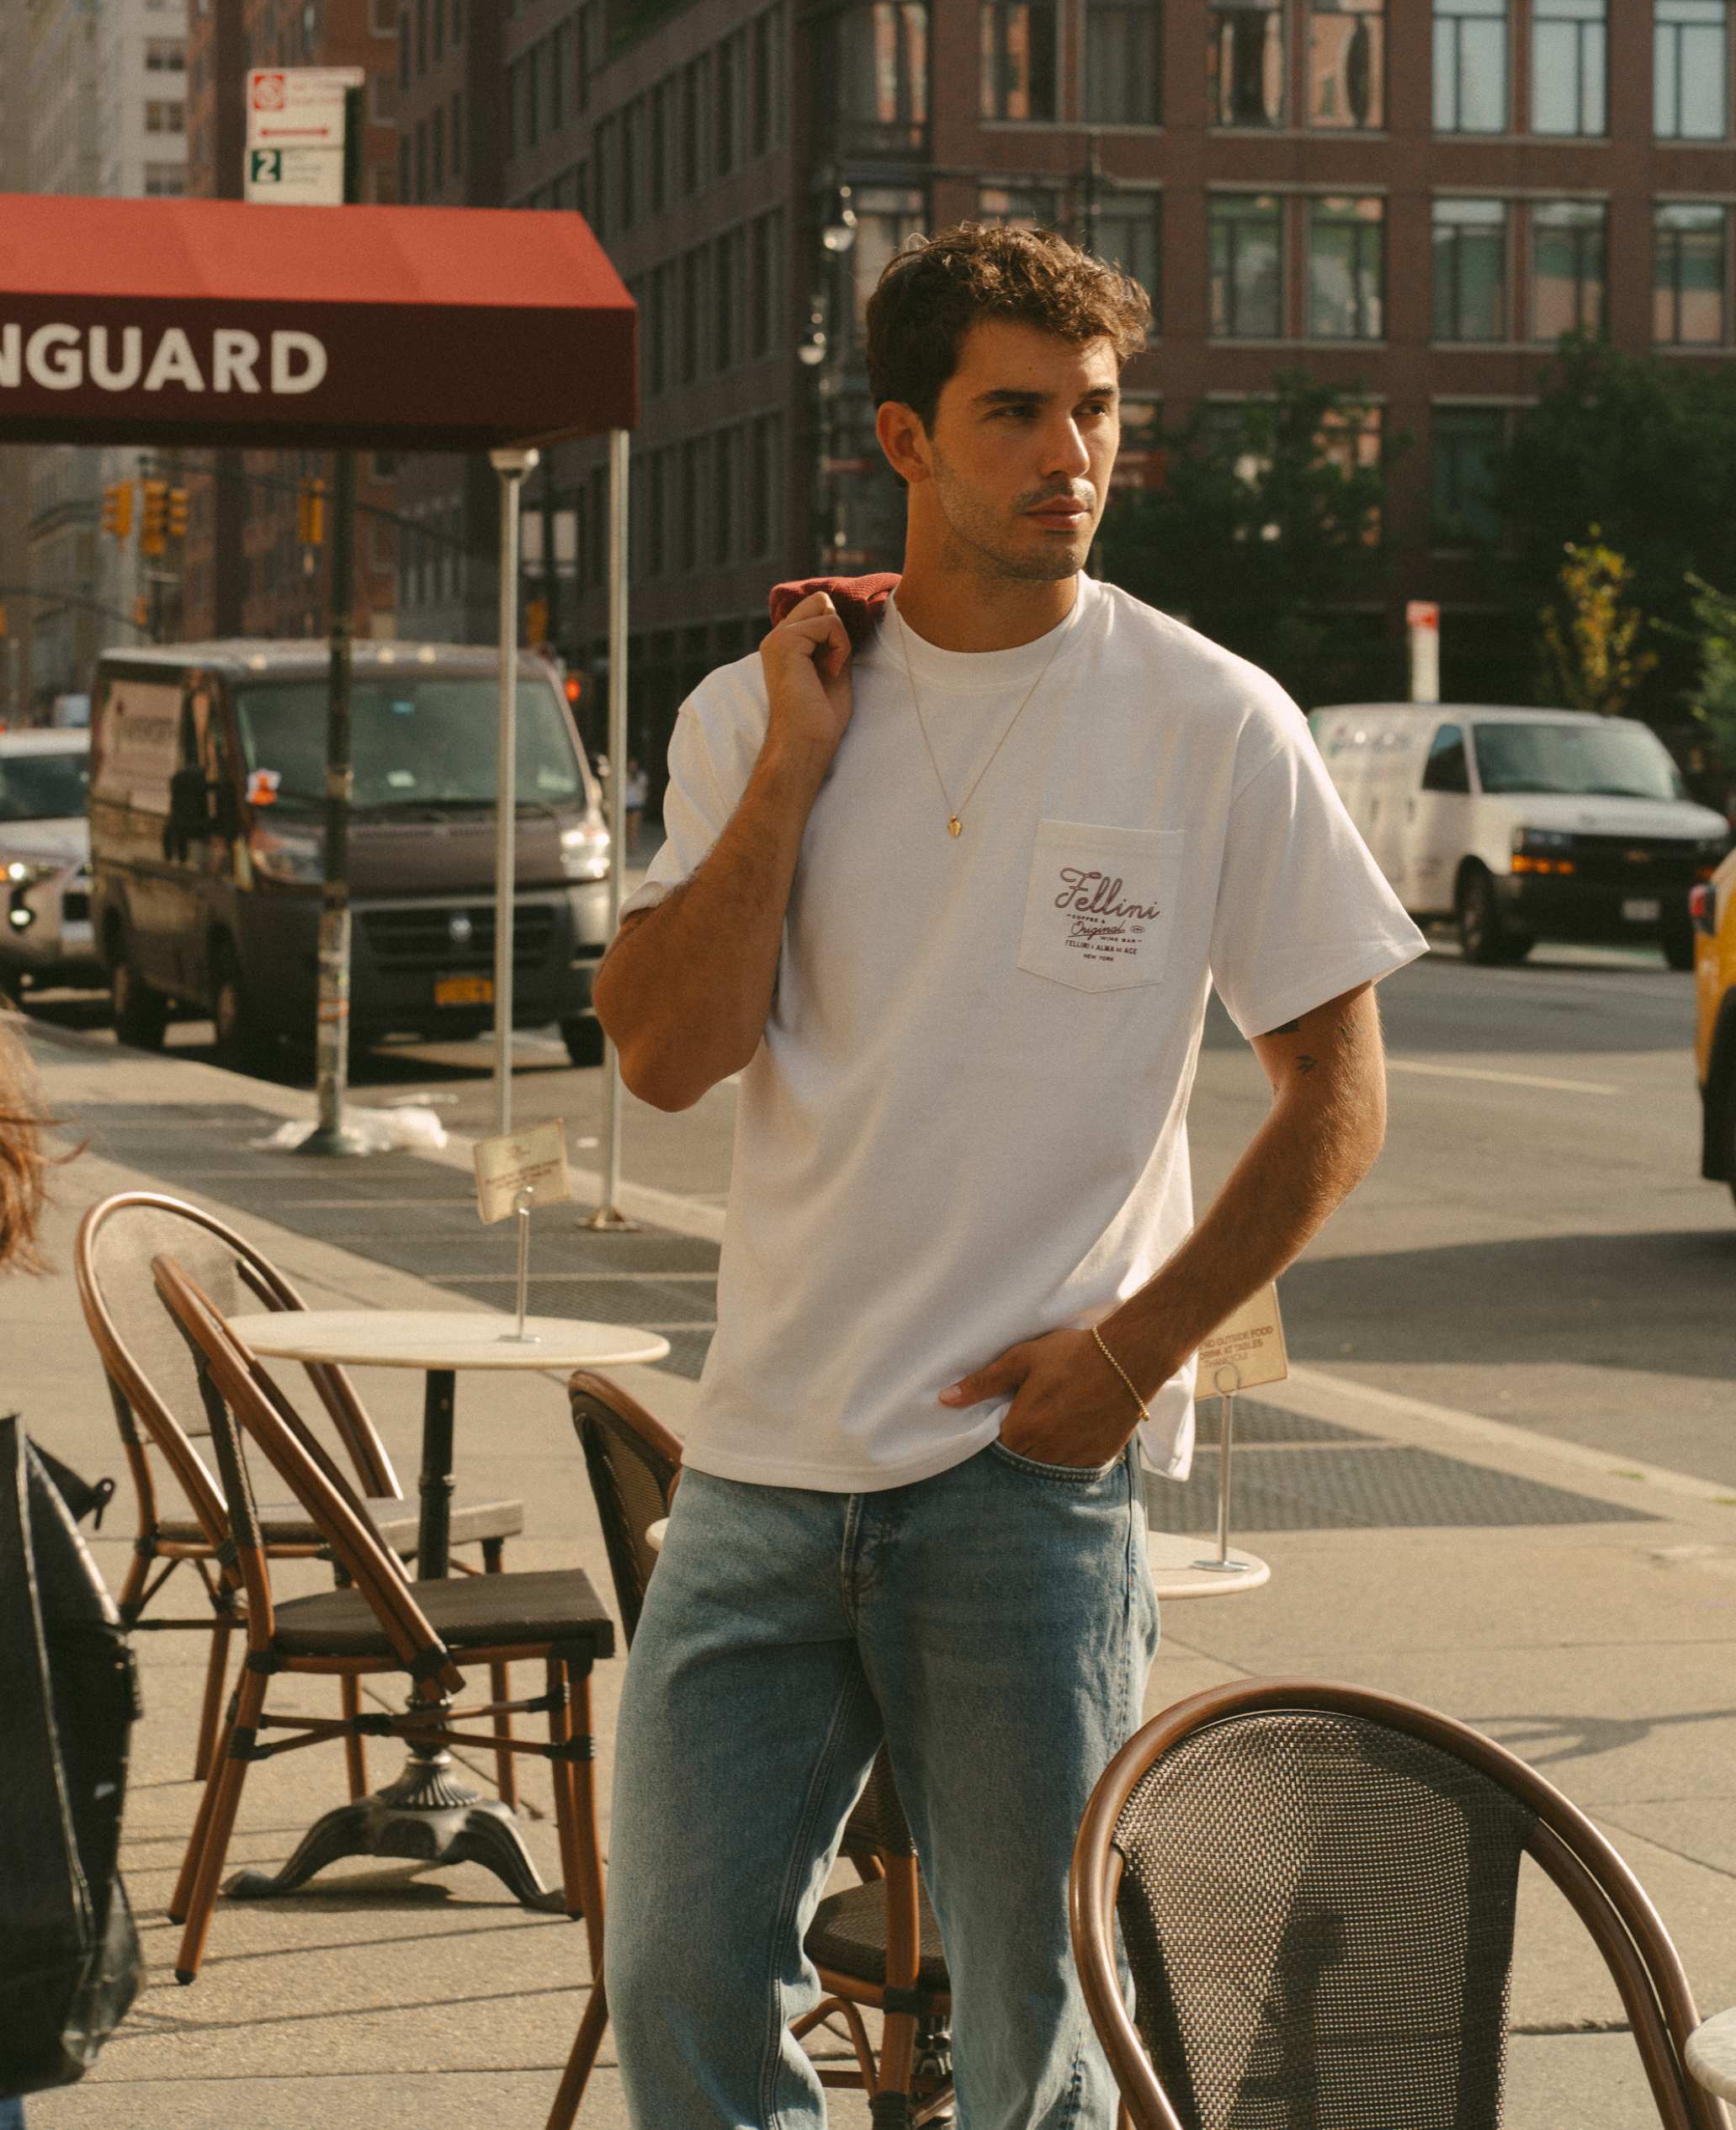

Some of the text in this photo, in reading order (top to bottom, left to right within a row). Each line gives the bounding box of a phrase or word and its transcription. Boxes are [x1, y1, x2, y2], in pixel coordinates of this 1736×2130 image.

[1054, 867, 1160, 920] Fellini
[1072, 915, 1098, 923] COFFEE
[1070, 920, 1126, 940] Original
[1064, 940, 1090, 948] FELLINI
[1205, 1338, 1216, 1348] NO
[1217, 1331, 1250, 1346] OUTSIDE
[1250, 1326, 1273, 1338] FOOD
[1199, 1339, 1263, 1361] DRINK AT TABLES
